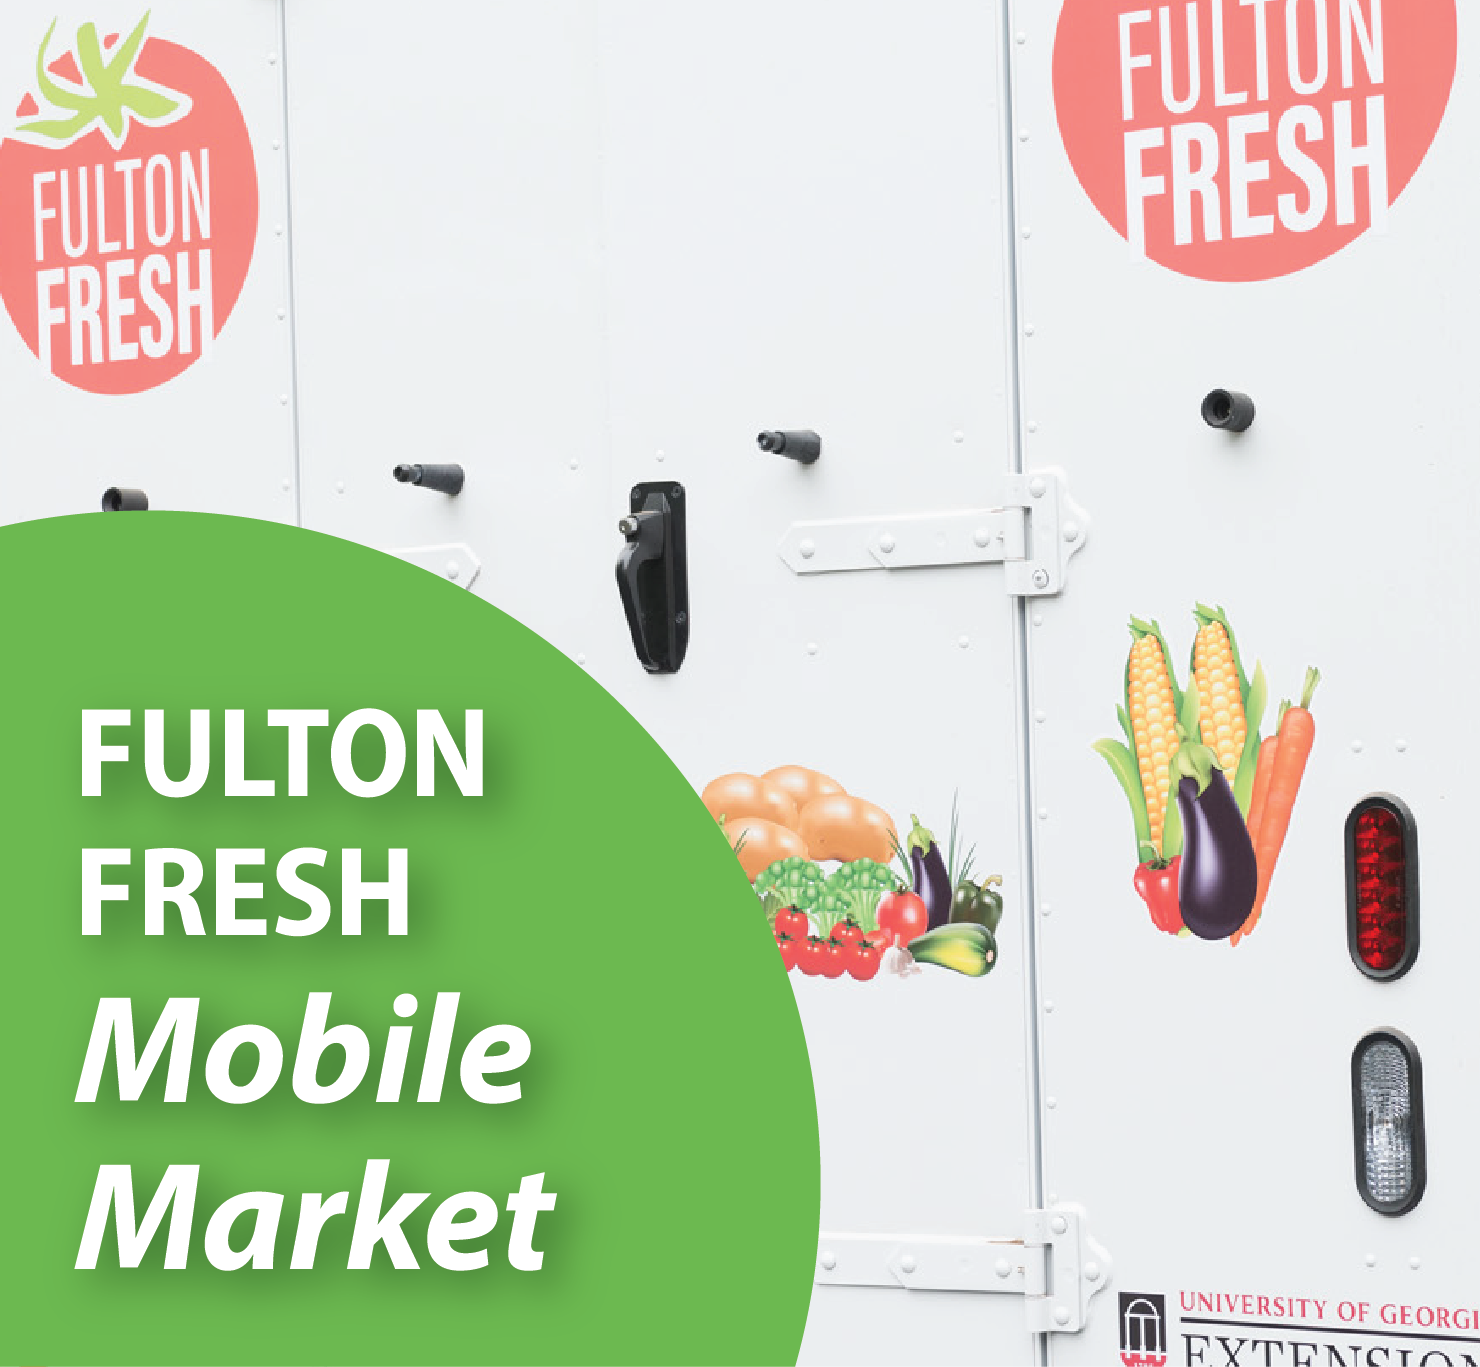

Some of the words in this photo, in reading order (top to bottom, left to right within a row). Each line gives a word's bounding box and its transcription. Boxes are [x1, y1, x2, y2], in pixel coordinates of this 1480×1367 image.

[1117, 0, 1385, 121] FULTON
[33, 148, 211, 262] FULTON
[1123, 94, 1389, 263] FRESH
[36, 249, 213, 378] FRESH
[1179, 1290, 1328, 1320] UNIVERSITY
[1337, 1301, 1371, 1323] OF
